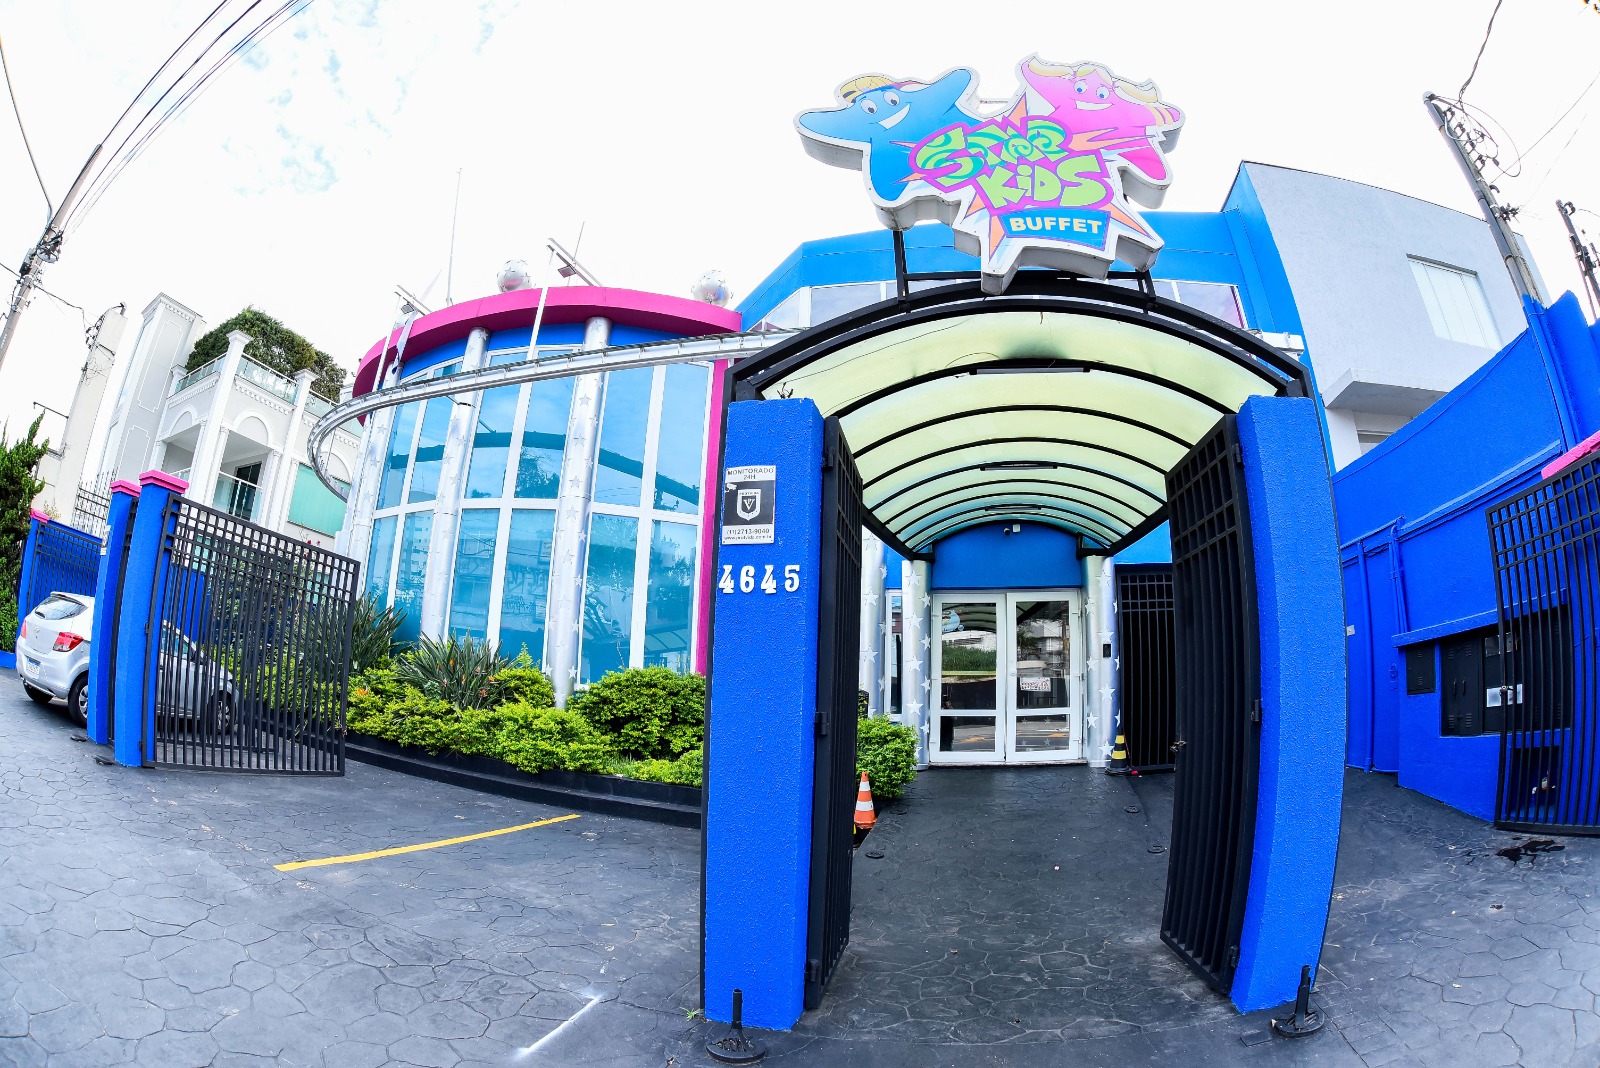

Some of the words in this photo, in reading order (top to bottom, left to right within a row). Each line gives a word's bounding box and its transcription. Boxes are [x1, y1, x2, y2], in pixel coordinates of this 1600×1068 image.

[1009, 216, 1102, 234] BUFFET
[727, 467, 774, 475] MONITORADO
[718, 564, 800, 594] 4645
